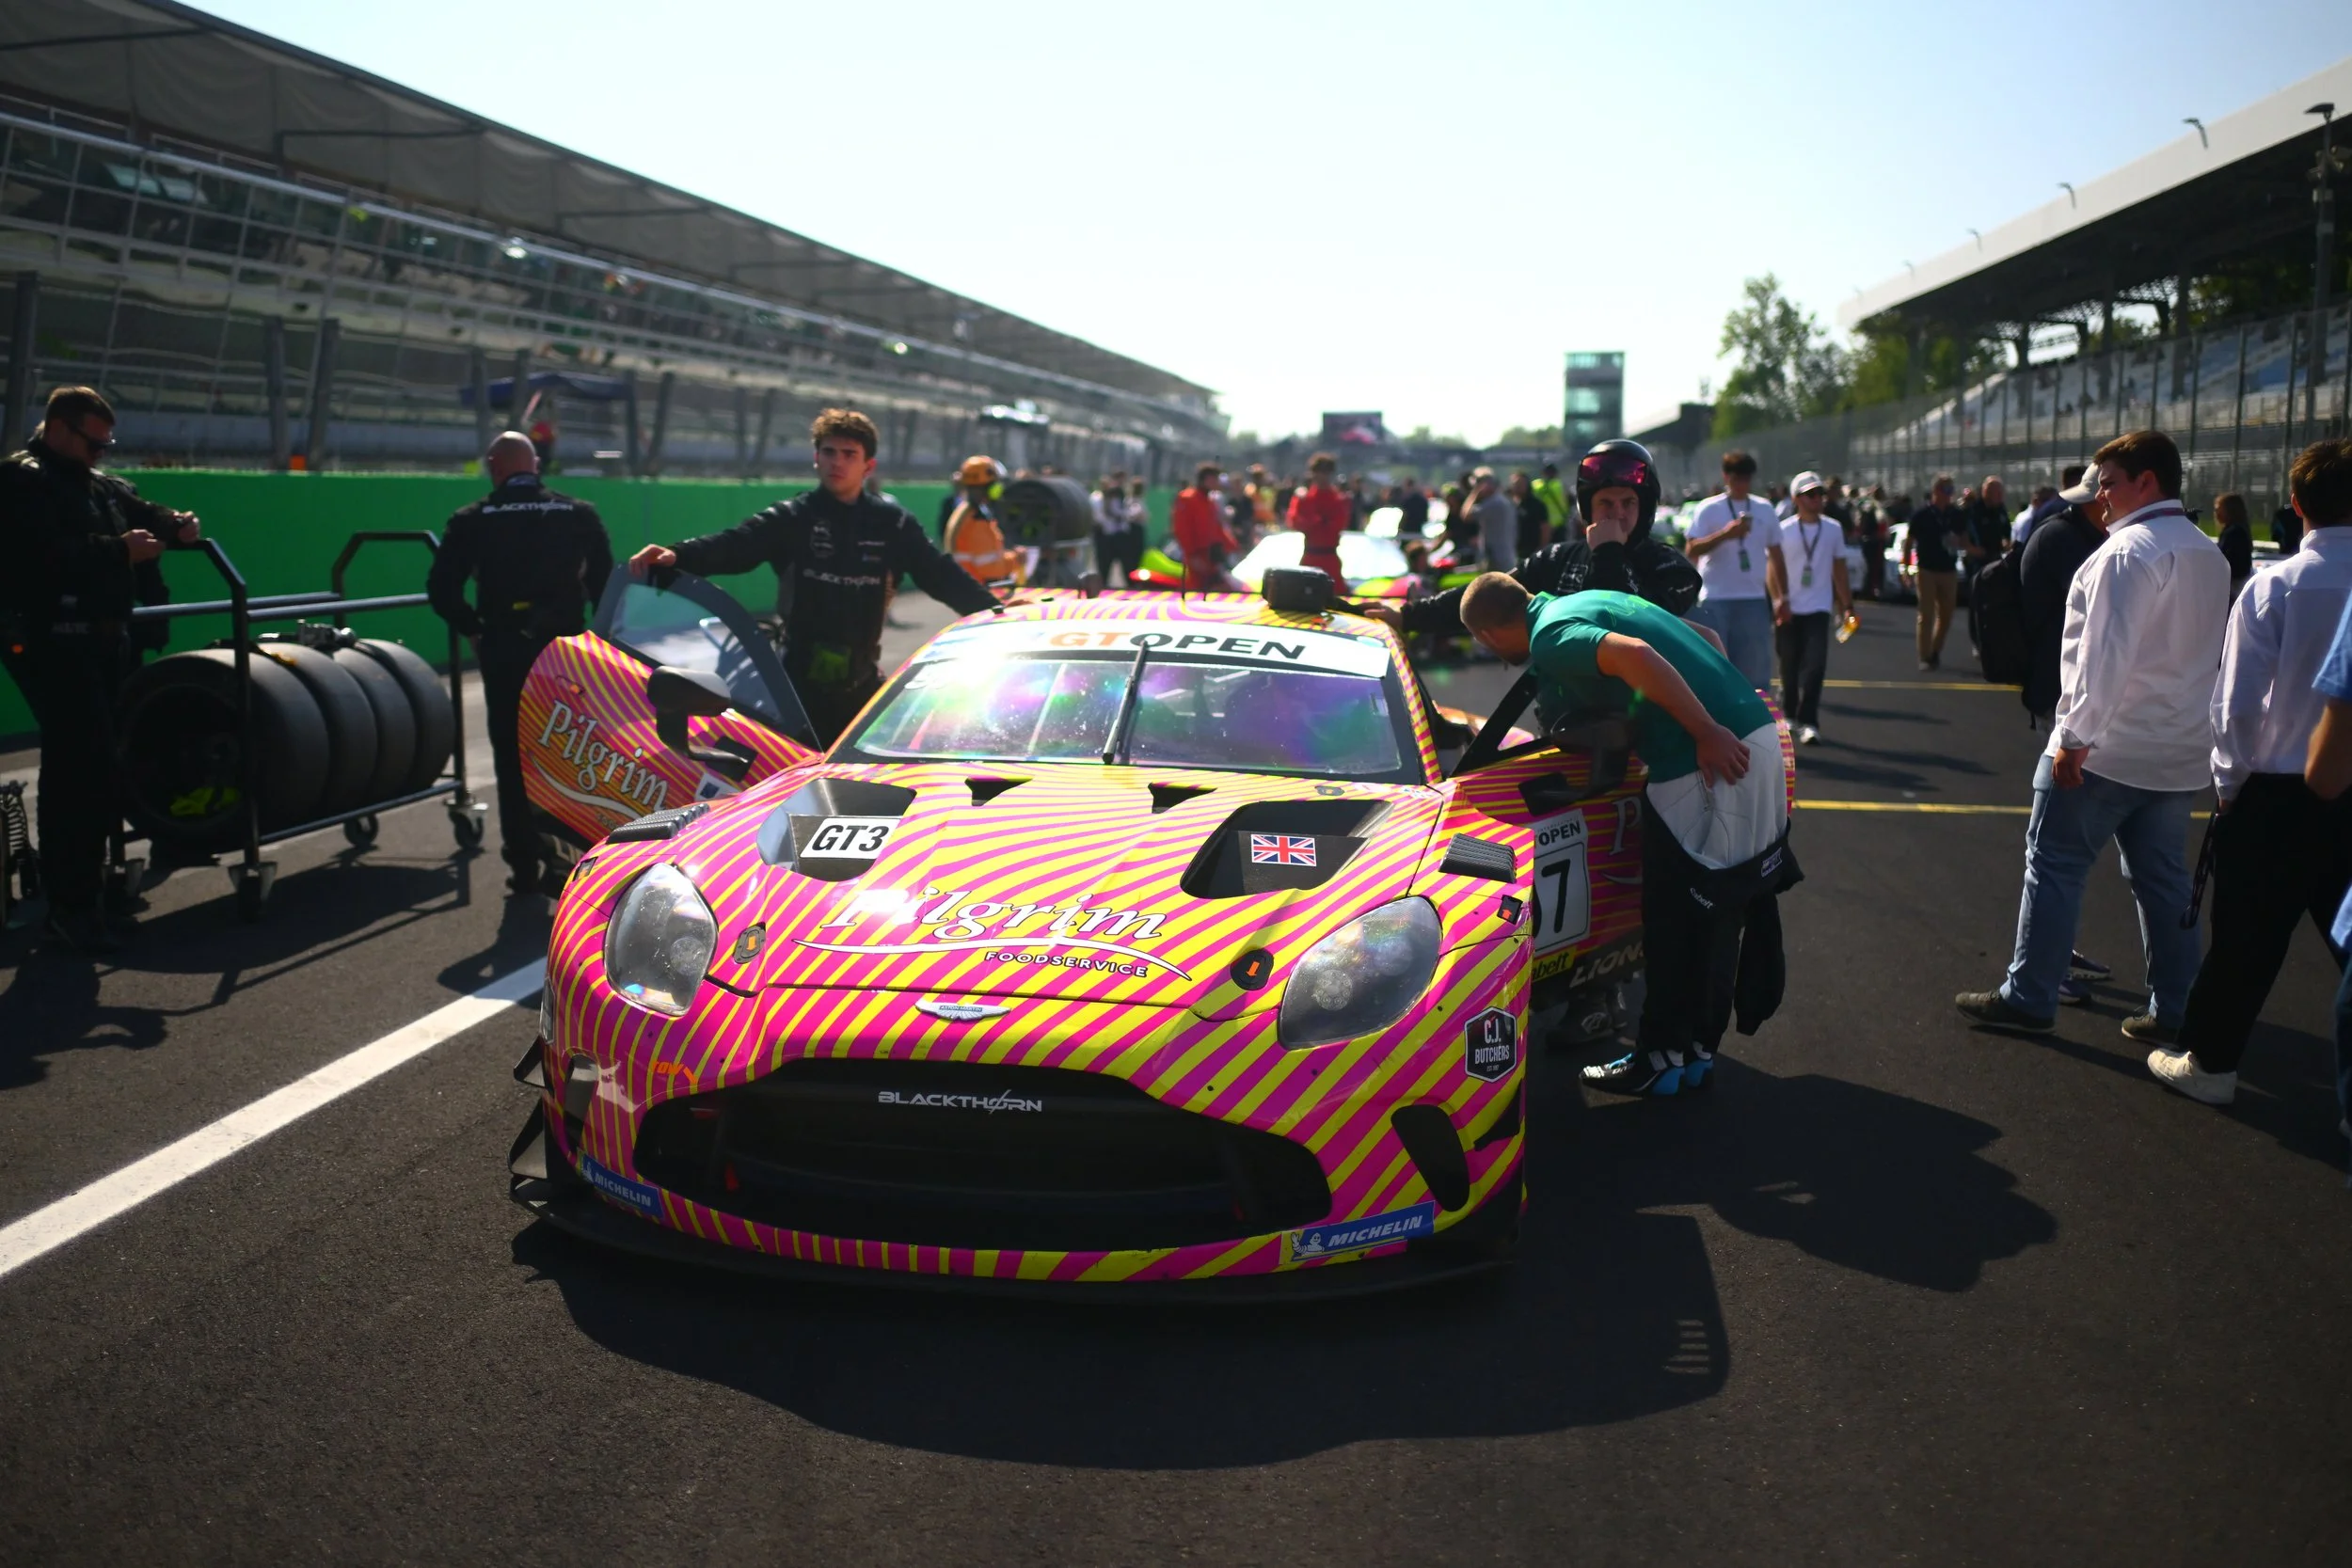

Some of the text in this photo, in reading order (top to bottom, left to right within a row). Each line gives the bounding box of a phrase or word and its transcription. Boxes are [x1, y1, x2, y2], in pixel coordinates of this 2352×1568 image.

[538, 700, 668, 812] Pilgrim
[812, 824, 889, 852] GT3
[819, 886, 1169, 941] Pilgrim
[1534, 859, 1571, 938] 7
[983, 951, 1149, 978] FOODSERVICE
[1569, 942, 1645, 989] LION
[1485, 1018, 1502, 1044] C.J.
[652, 1060, 684, 1074] TOW
[1474, 1045, 1510, 1065] BUTCHERS
[878, 1088, 1042, 1115] BLACKTHORN
[595, 1172, 652, 1207] MICHELIN
[1327, 1214, 1423, 1247] MICHELIN
